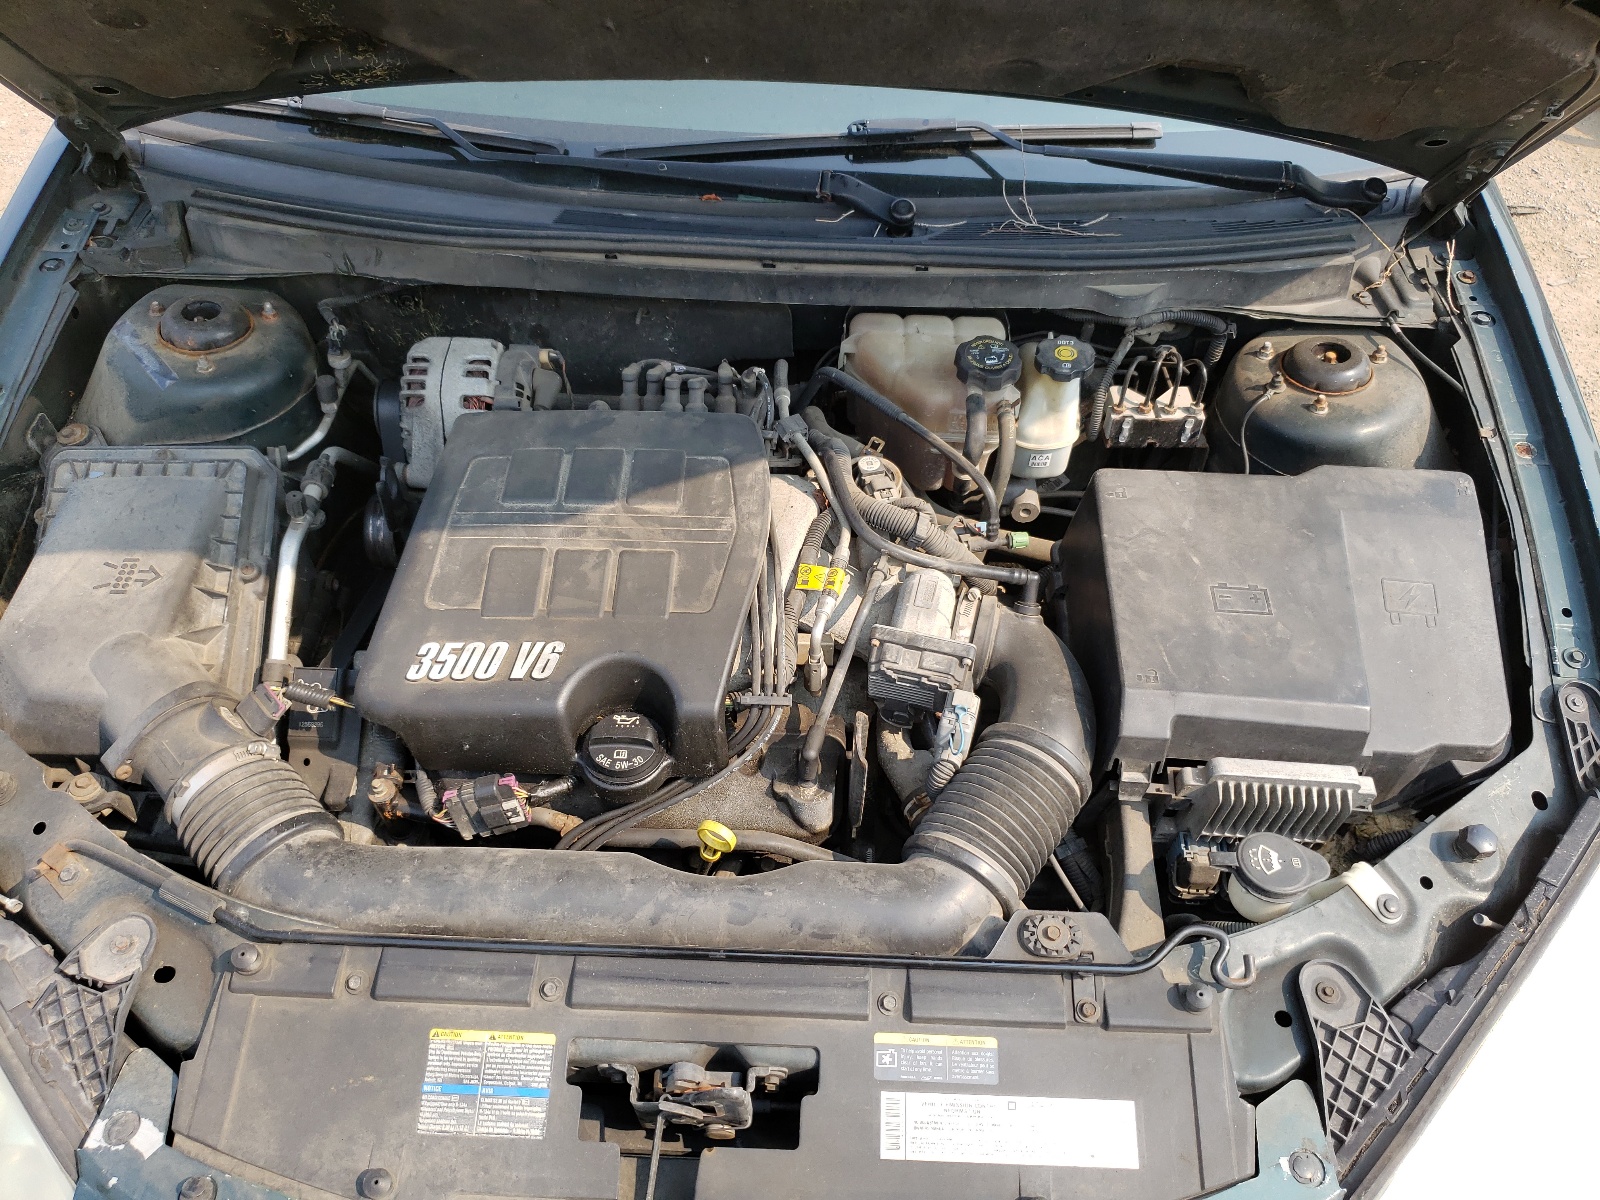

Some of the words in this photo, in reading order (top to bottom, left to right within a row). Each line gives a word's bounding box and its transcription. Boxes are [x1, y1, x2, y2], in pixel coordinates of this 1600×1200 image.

[404, 641, 509, 682] 3500
[509, 640, 566, 682] V6
[596, 754, 611, 768] SAE
[614, 755, 644, 770] 5W-30
